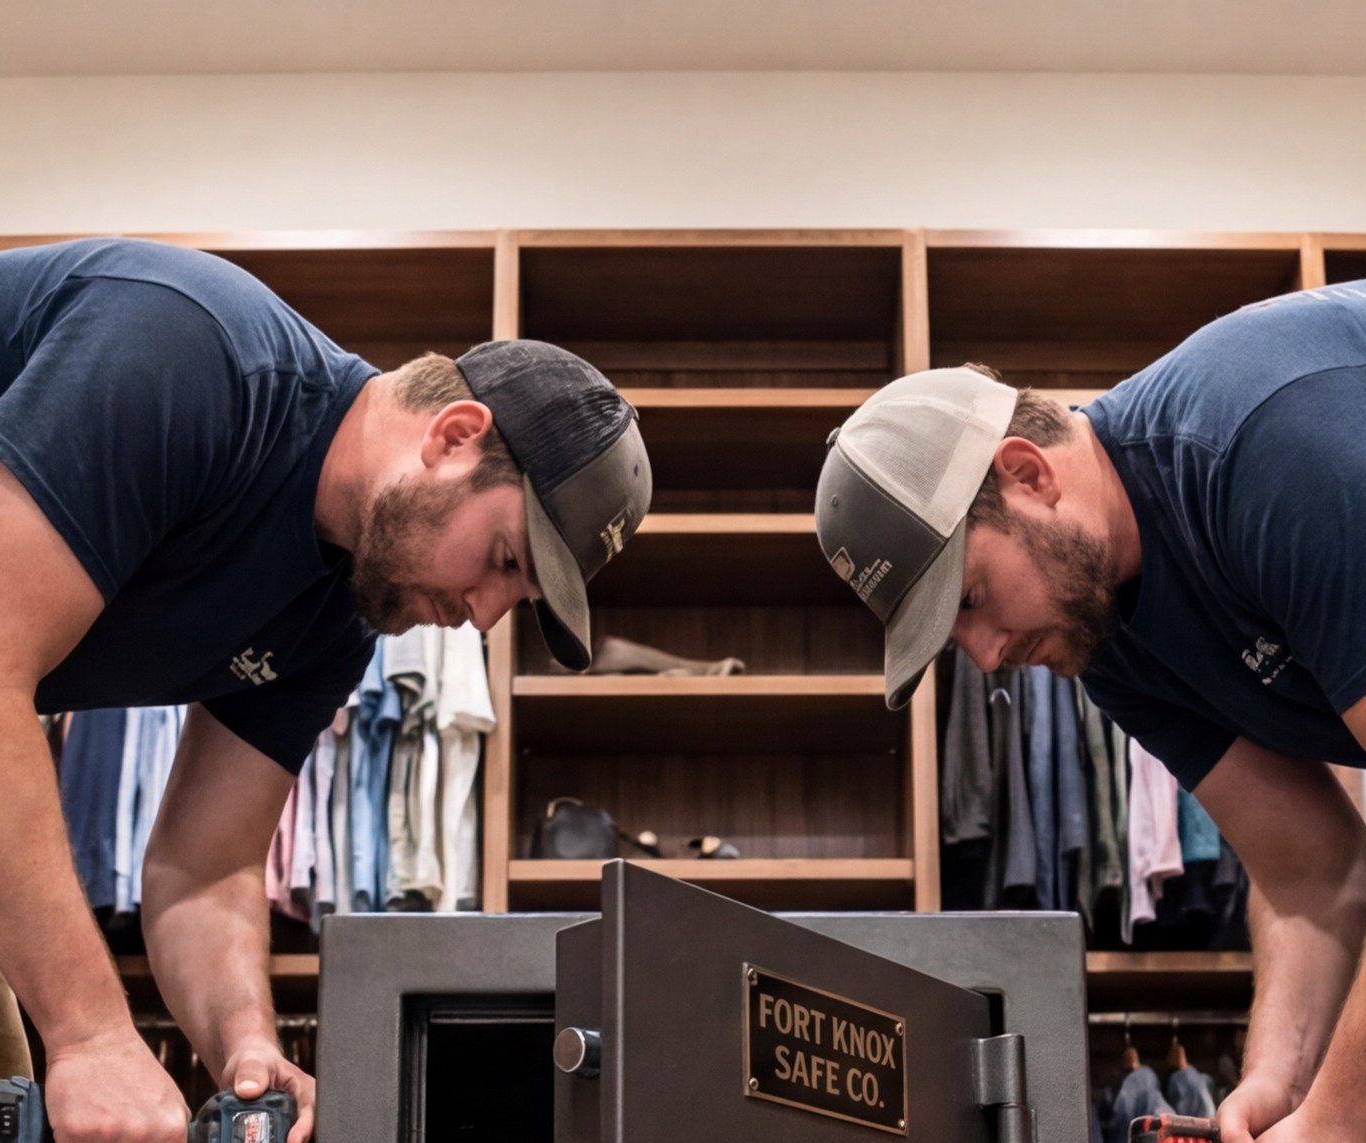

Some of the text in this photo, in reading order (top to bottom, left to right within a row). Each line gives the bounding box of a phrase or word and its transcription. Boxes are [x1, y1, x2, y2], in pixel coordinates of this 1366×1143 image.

[759, 993, 896, 1069] FORT KNOX
[775, 1045, 885, 1108] SAFE CO.
